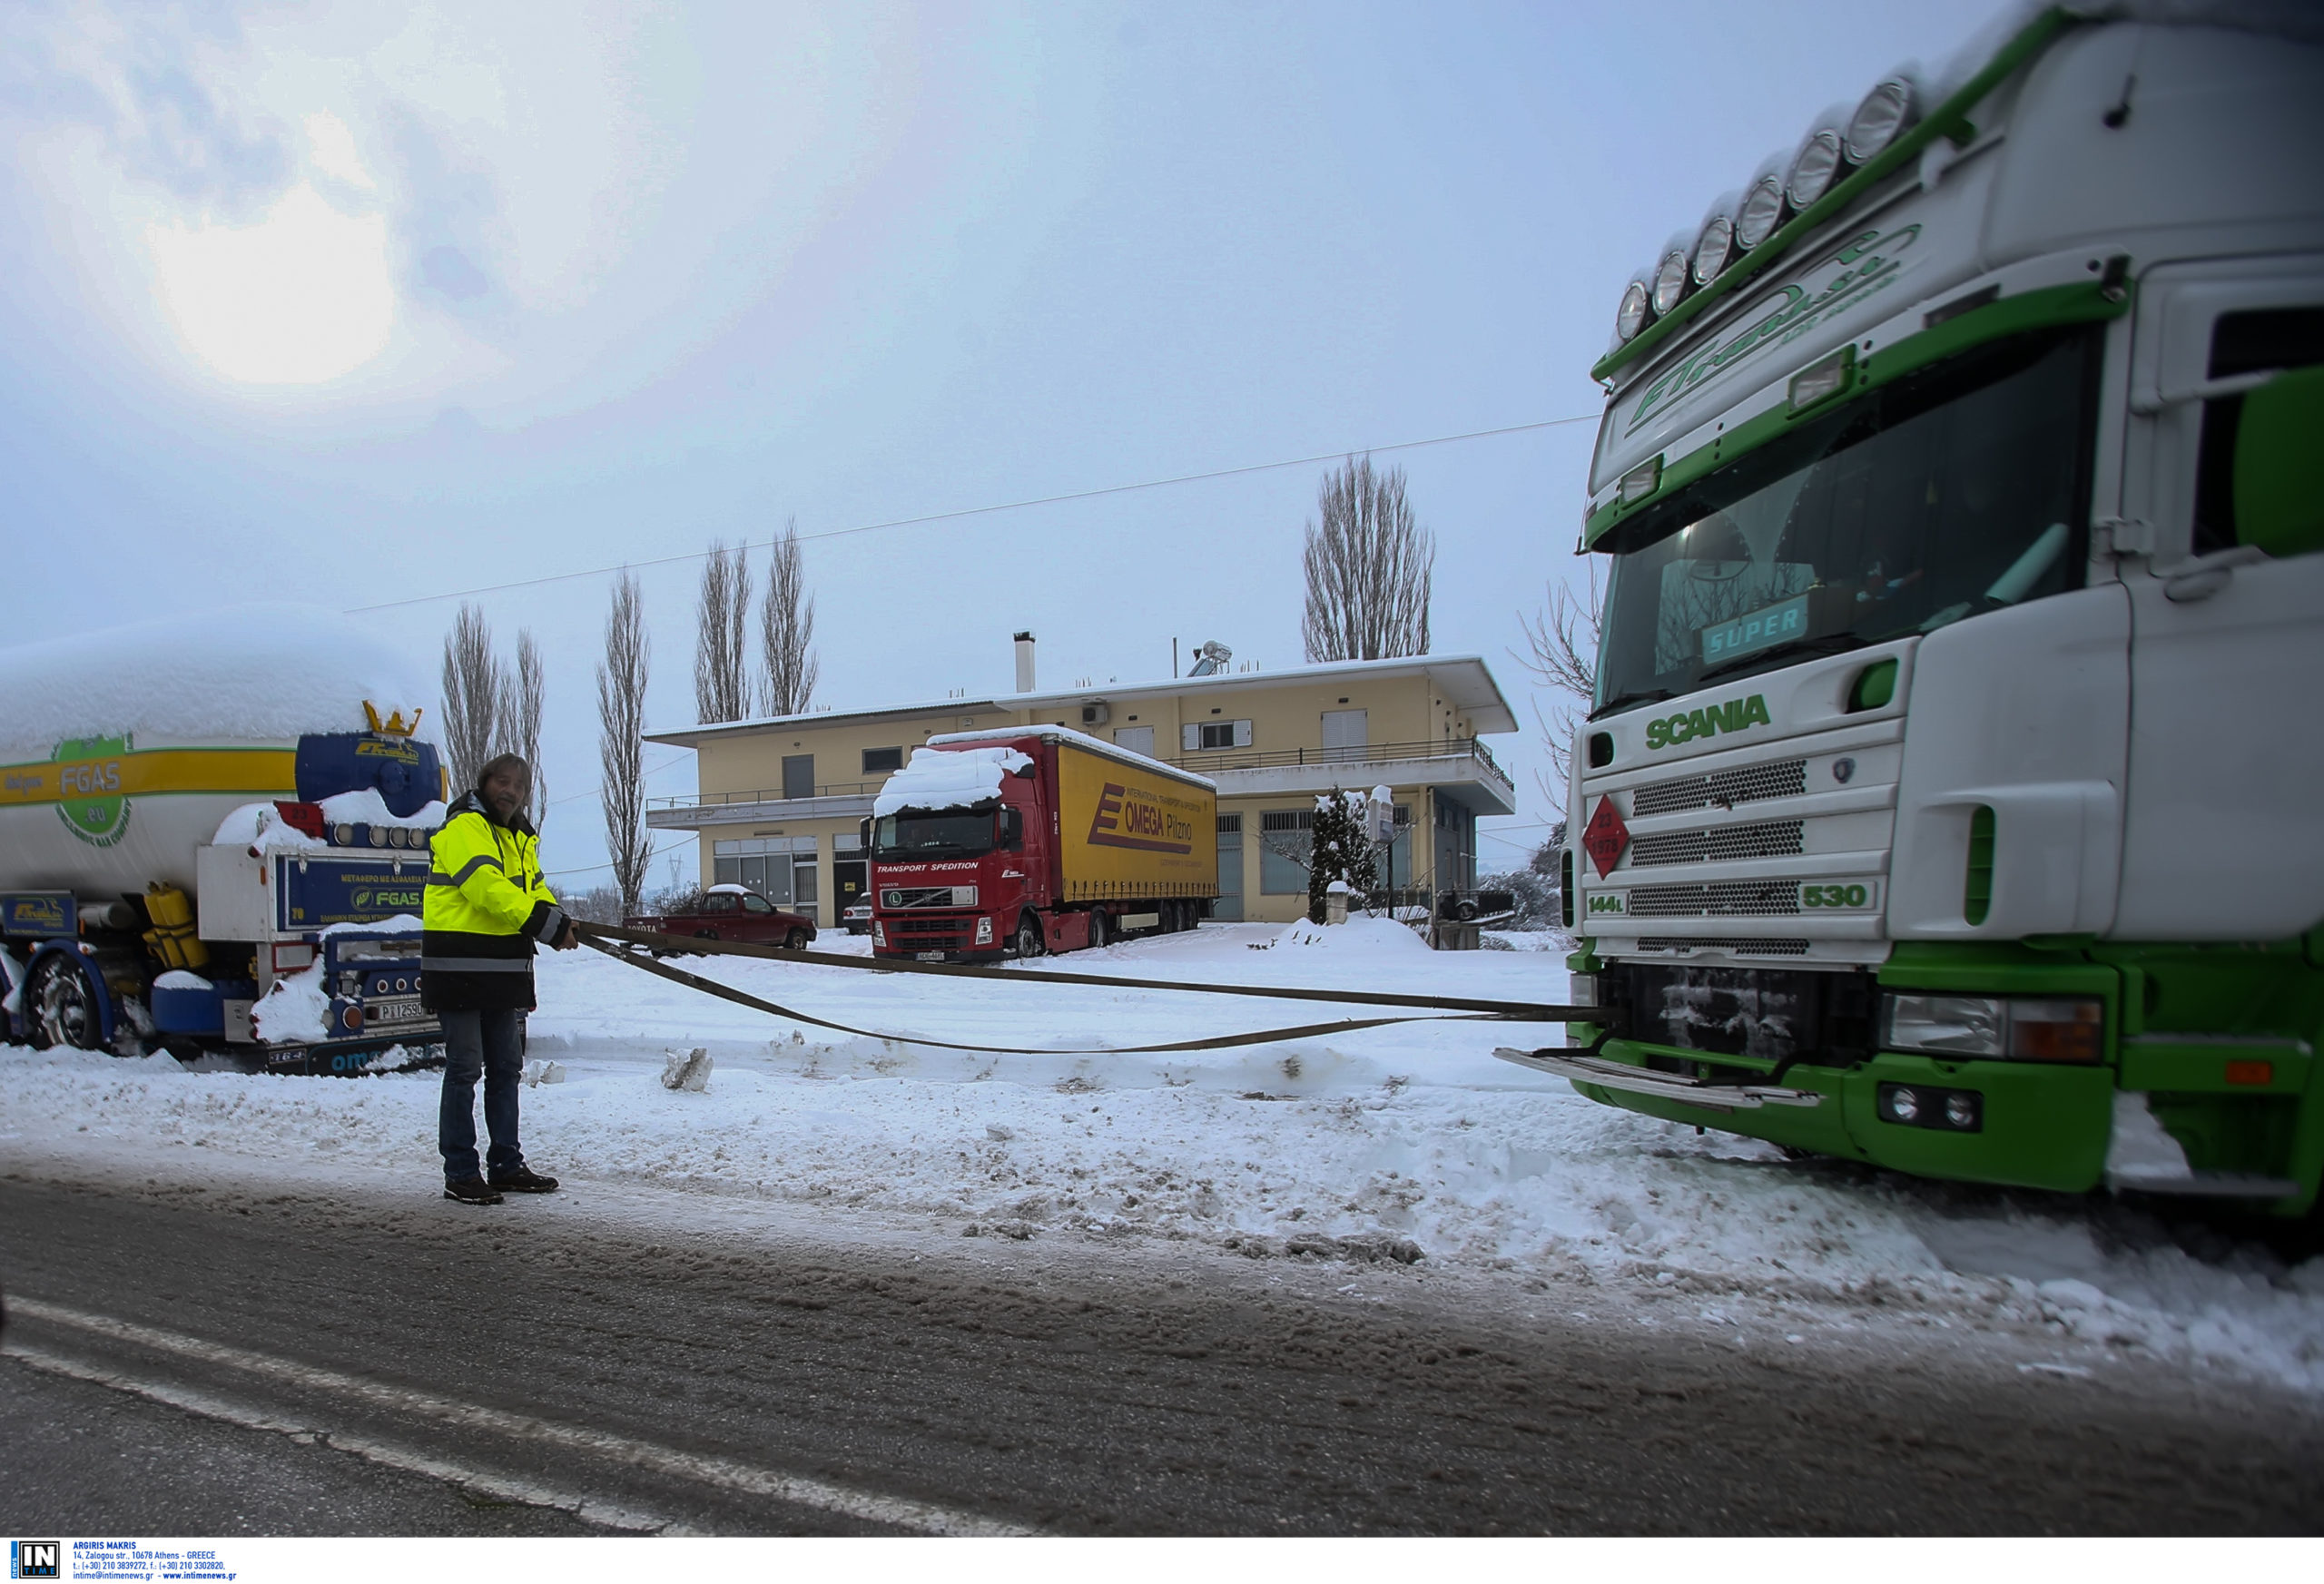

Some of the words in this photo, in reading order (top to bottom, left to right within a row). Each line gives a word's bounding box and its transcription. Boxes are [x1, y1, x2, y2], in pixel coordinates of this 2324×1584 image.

[1709, 608, 1798, 654] SUPER
[1646, 694, 1770, 750] SCANIA
[60, 762, 120, 794] FGAS
[1125, 801, 1165, 837] OMEGA
[1167, 813, 1192, 841] Pilzno
[1599, 813, 1612, 828] 23
[1592, 839, 1619, 855] 1978
[877, 864, 928, 873] TRANSPORT
[931, 862, 980, 871] SPEDITION
[1802, 884, 1866, 908] 530
[397, 1003, 423, 1016] 12590
